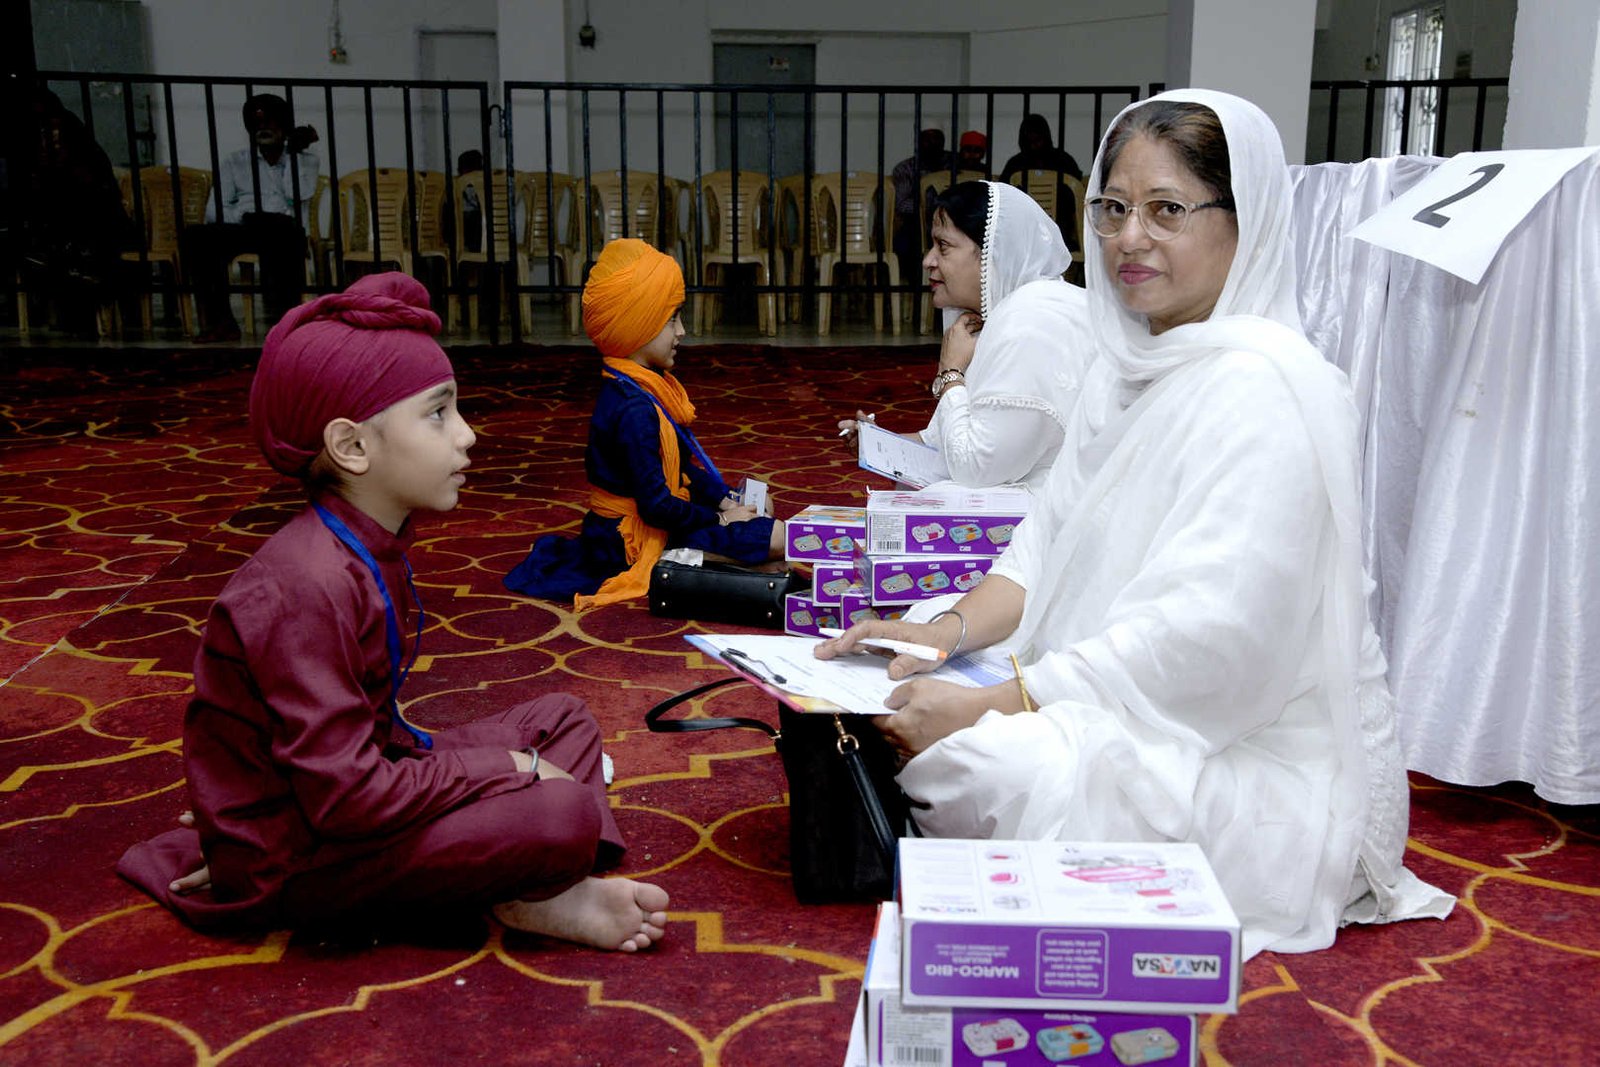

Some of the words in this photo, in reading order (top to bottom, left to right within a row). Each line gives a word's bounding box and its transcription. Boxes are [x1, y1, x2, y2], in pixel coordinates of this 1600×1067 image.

[1412, 164, 1505, 228] 2
[924, 964, 1019, 978] MARCO-BIG
[1136, 956, 1217, 975] NAYASA
